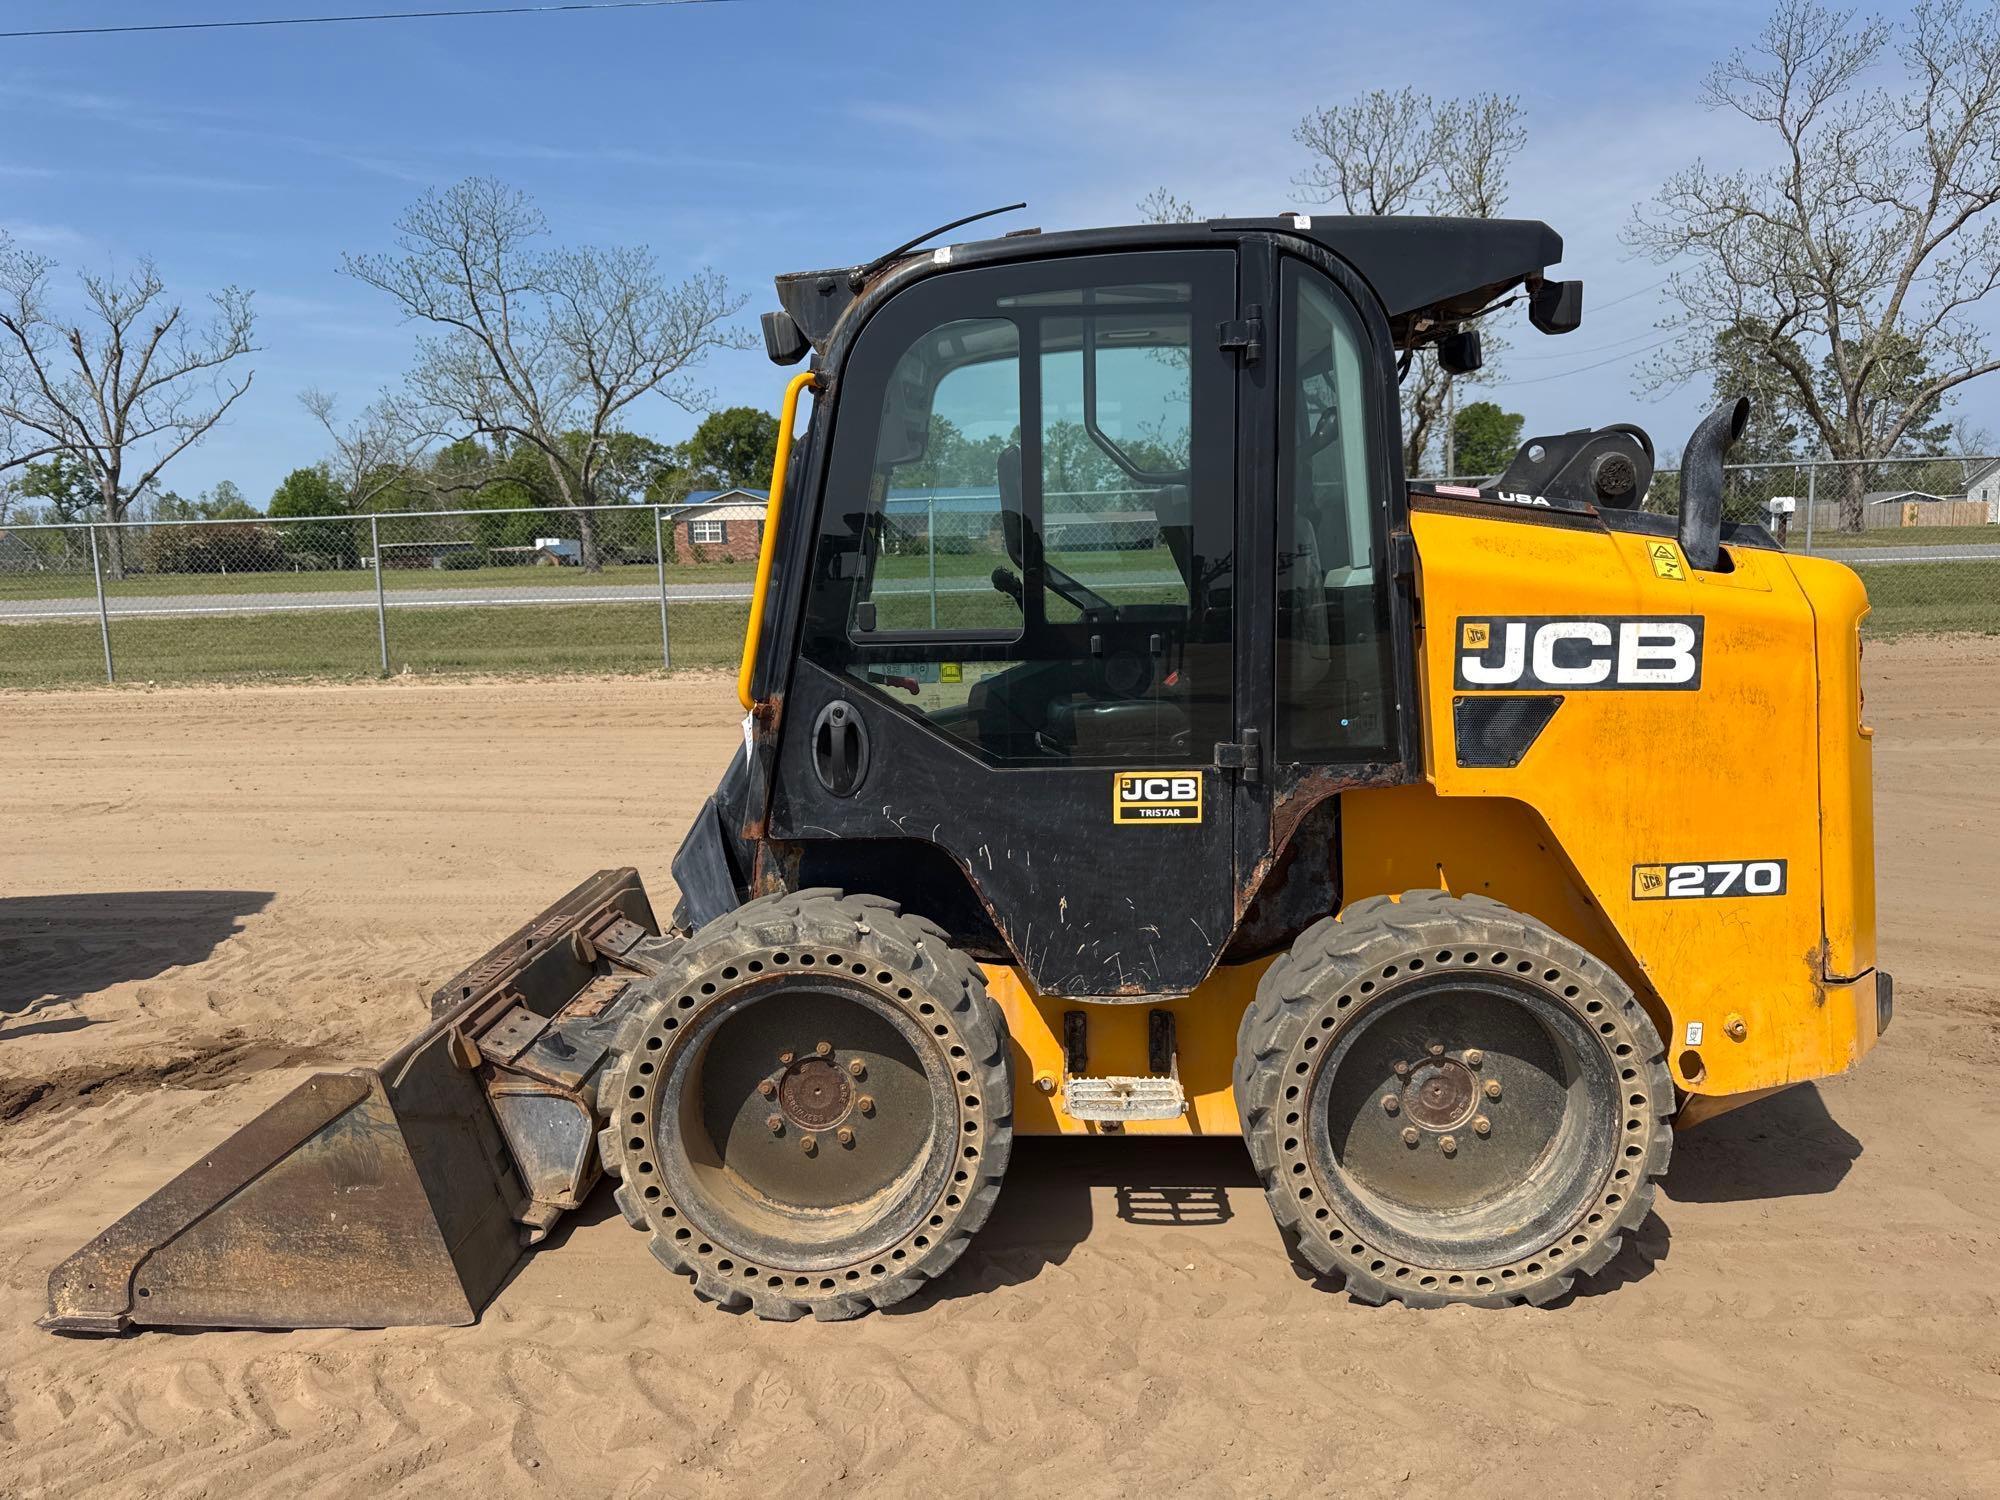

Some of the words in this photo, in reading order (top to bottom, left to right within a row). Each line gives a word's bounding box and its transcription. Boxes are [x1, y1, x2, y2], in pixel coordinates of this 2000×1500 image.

[1498, 491, 1551, 506] USA
[1461, 622, 1696, 684] JCB
[1122, 778, 1197, 800] JCB
[1139, 808, 1181, 817] TRISTAR
[1668, 862, 1781, 897] 270
